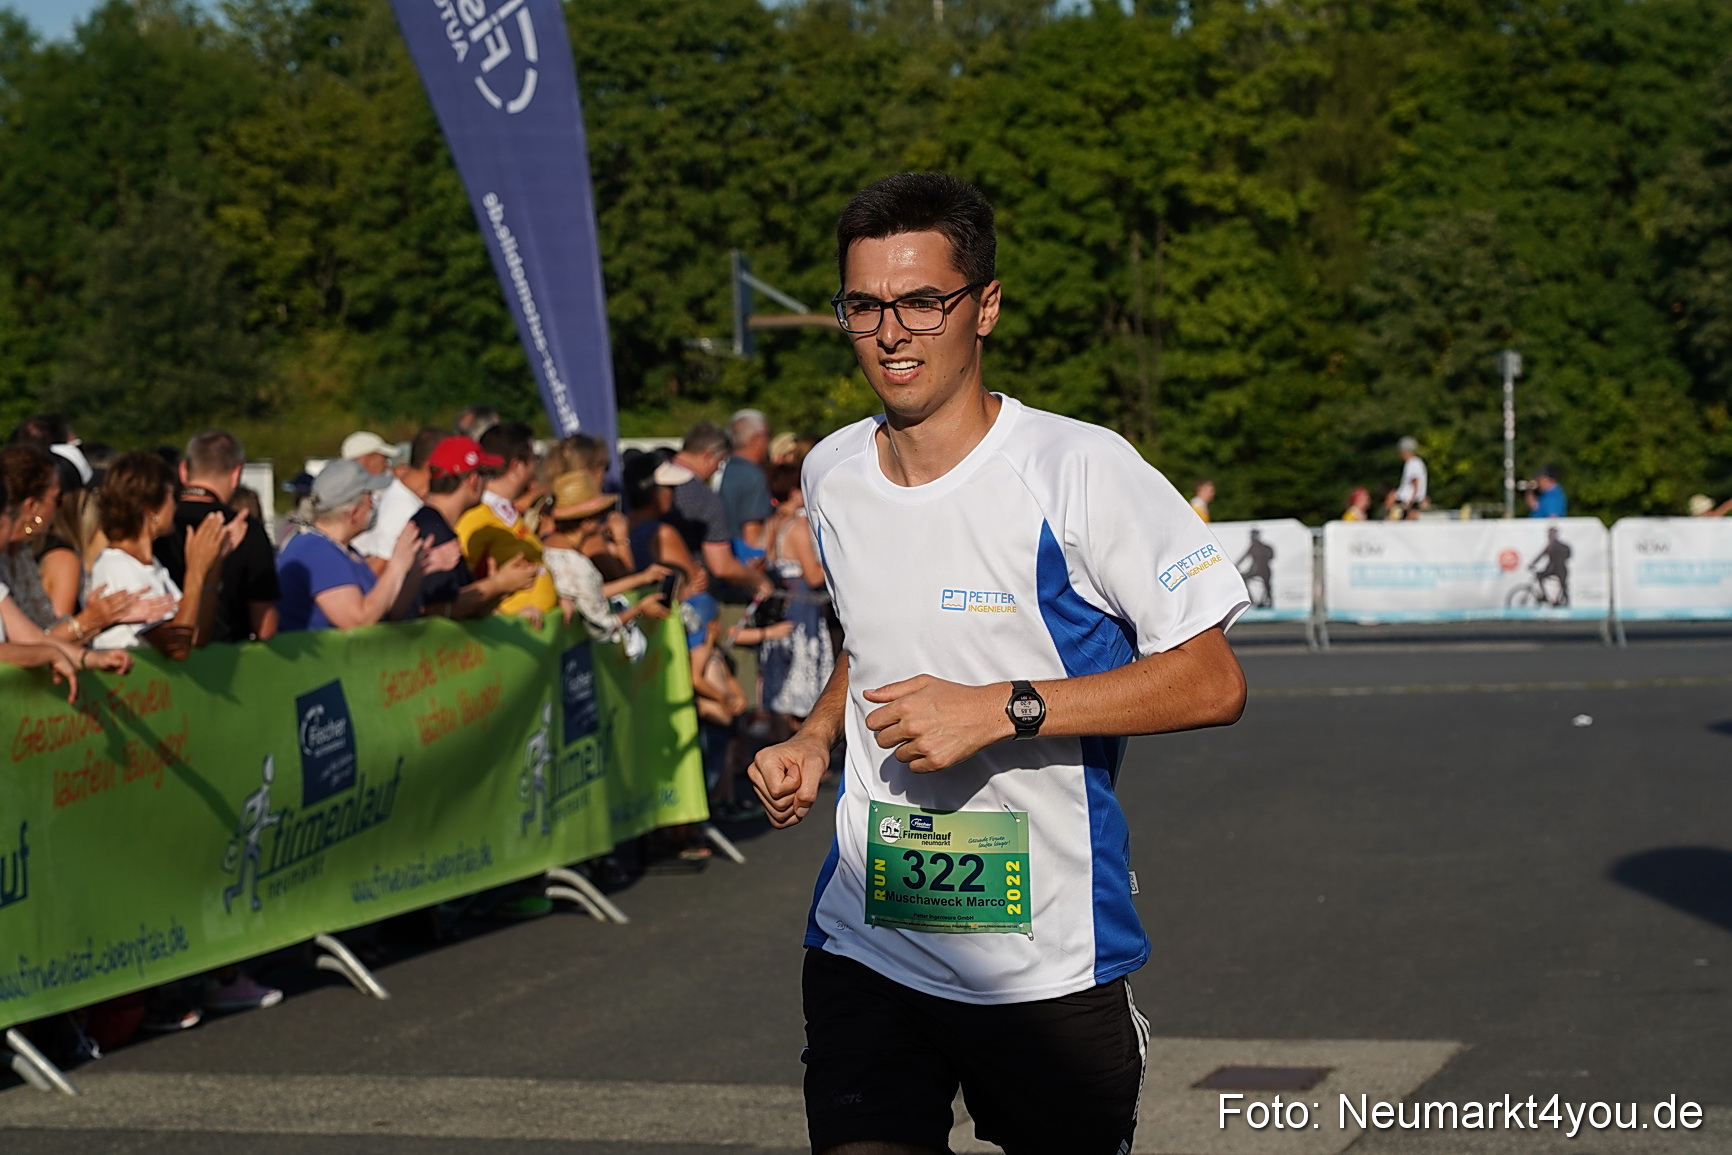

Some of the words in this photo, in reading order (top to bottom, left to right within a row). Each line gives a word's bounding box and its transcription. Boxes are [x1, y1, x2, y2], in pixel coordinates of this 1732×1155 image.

[1177, 544, 1218, 572] PETTER
[969, 591, 1016, 605] PETTER
[968, 605, 1017, 614] INGENIEURE
[903, 830, 951, 841] Firmenlauf
[874, 858, 887, 902] RUN
[902, 850, 986, 893] 322
[1005, 860, 1022, 916] 2022
[886, 890, 962, 907] Muschaweck
[967, 895, 1006, 908] Marco
[913, 912, 928, 920] Petter
[928, 913, 956, 922] Ingenieure
